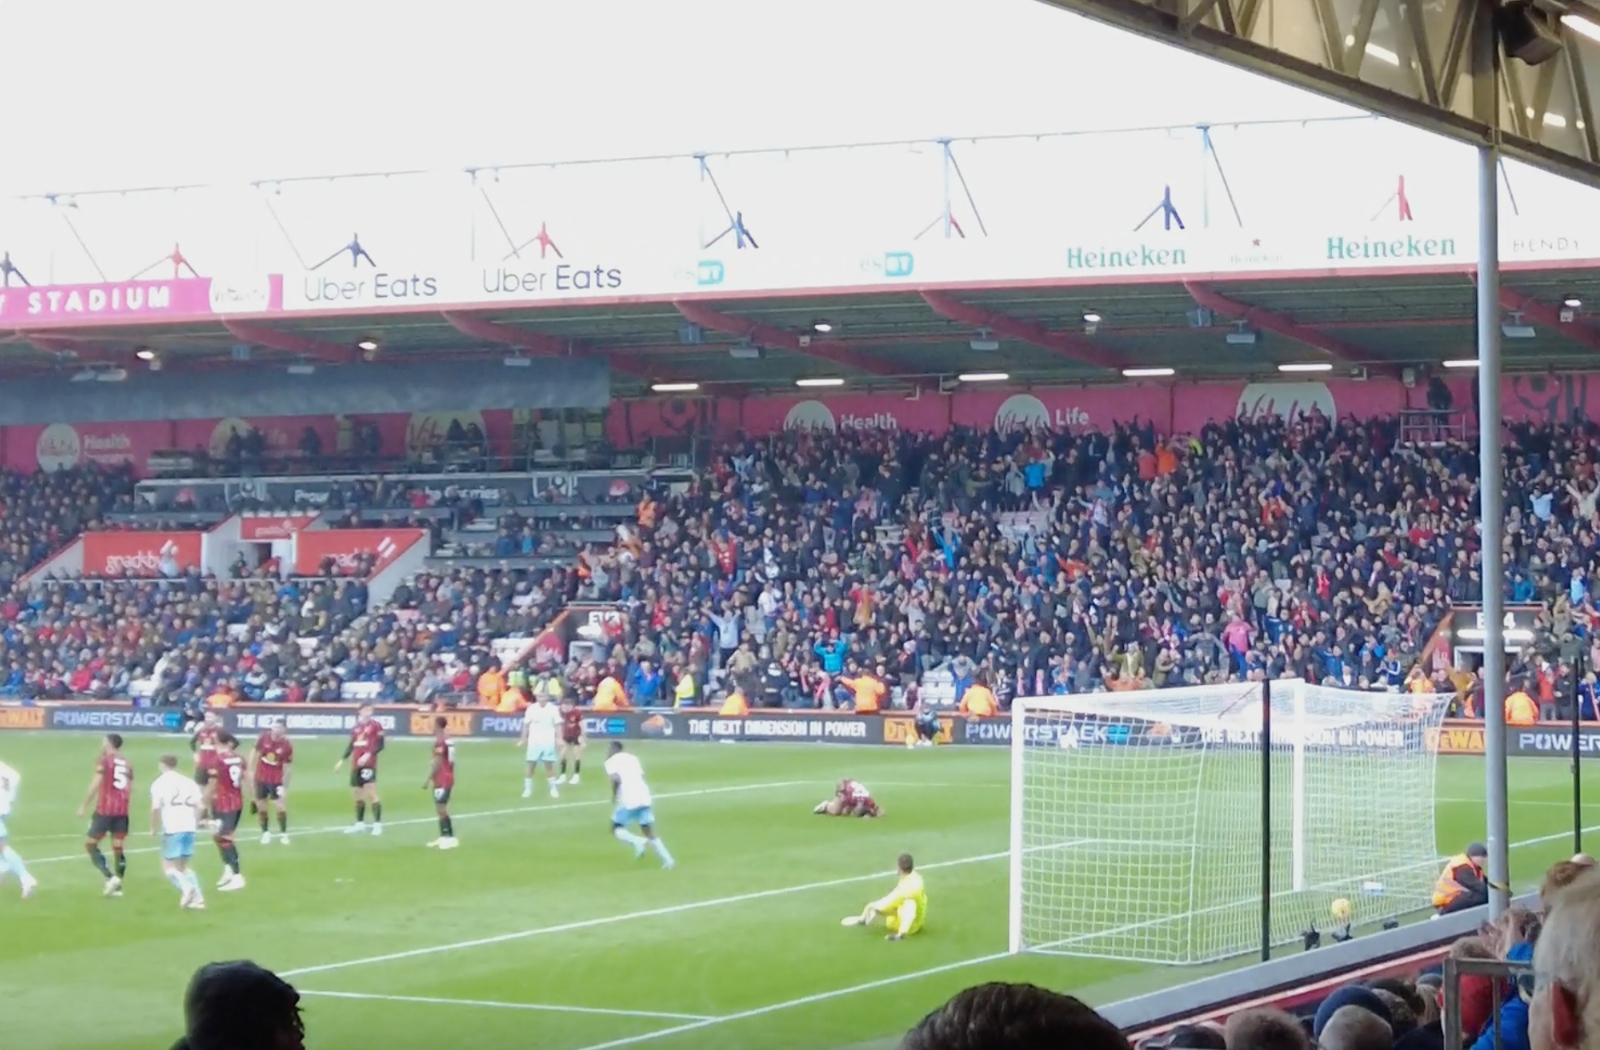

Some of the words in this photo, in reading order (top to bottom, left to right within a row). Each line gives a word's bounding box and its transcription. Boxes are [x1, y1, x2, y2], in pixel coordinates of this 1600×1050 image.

[1067, 244, 1187, 269] Heineken
[1326, 234, 1457, 260] Heineken
[303, 276, 366, 302] Uber
[373, 273, 438, 299] Eats
[482, 267, 548, 293] Uber
[555, 265, 623, 290] Eats
[27, 285, 171, 315] STADIUM
[840, 412, 898, 430] Health
[1055, 407, 1090, 426] Life
[53, 711, 165, 727] POWERSTACK
[688, 719, 710, 735] THE
[712, 719, 742, 735] NEXT
[744, 719, 808, 737] DIMENSION
[809, 720, 822, 737] IN
[824, 720, 867, 738] POWER
[113, 765, 127, 790] 5
[228, 765, 242, 788] 9
